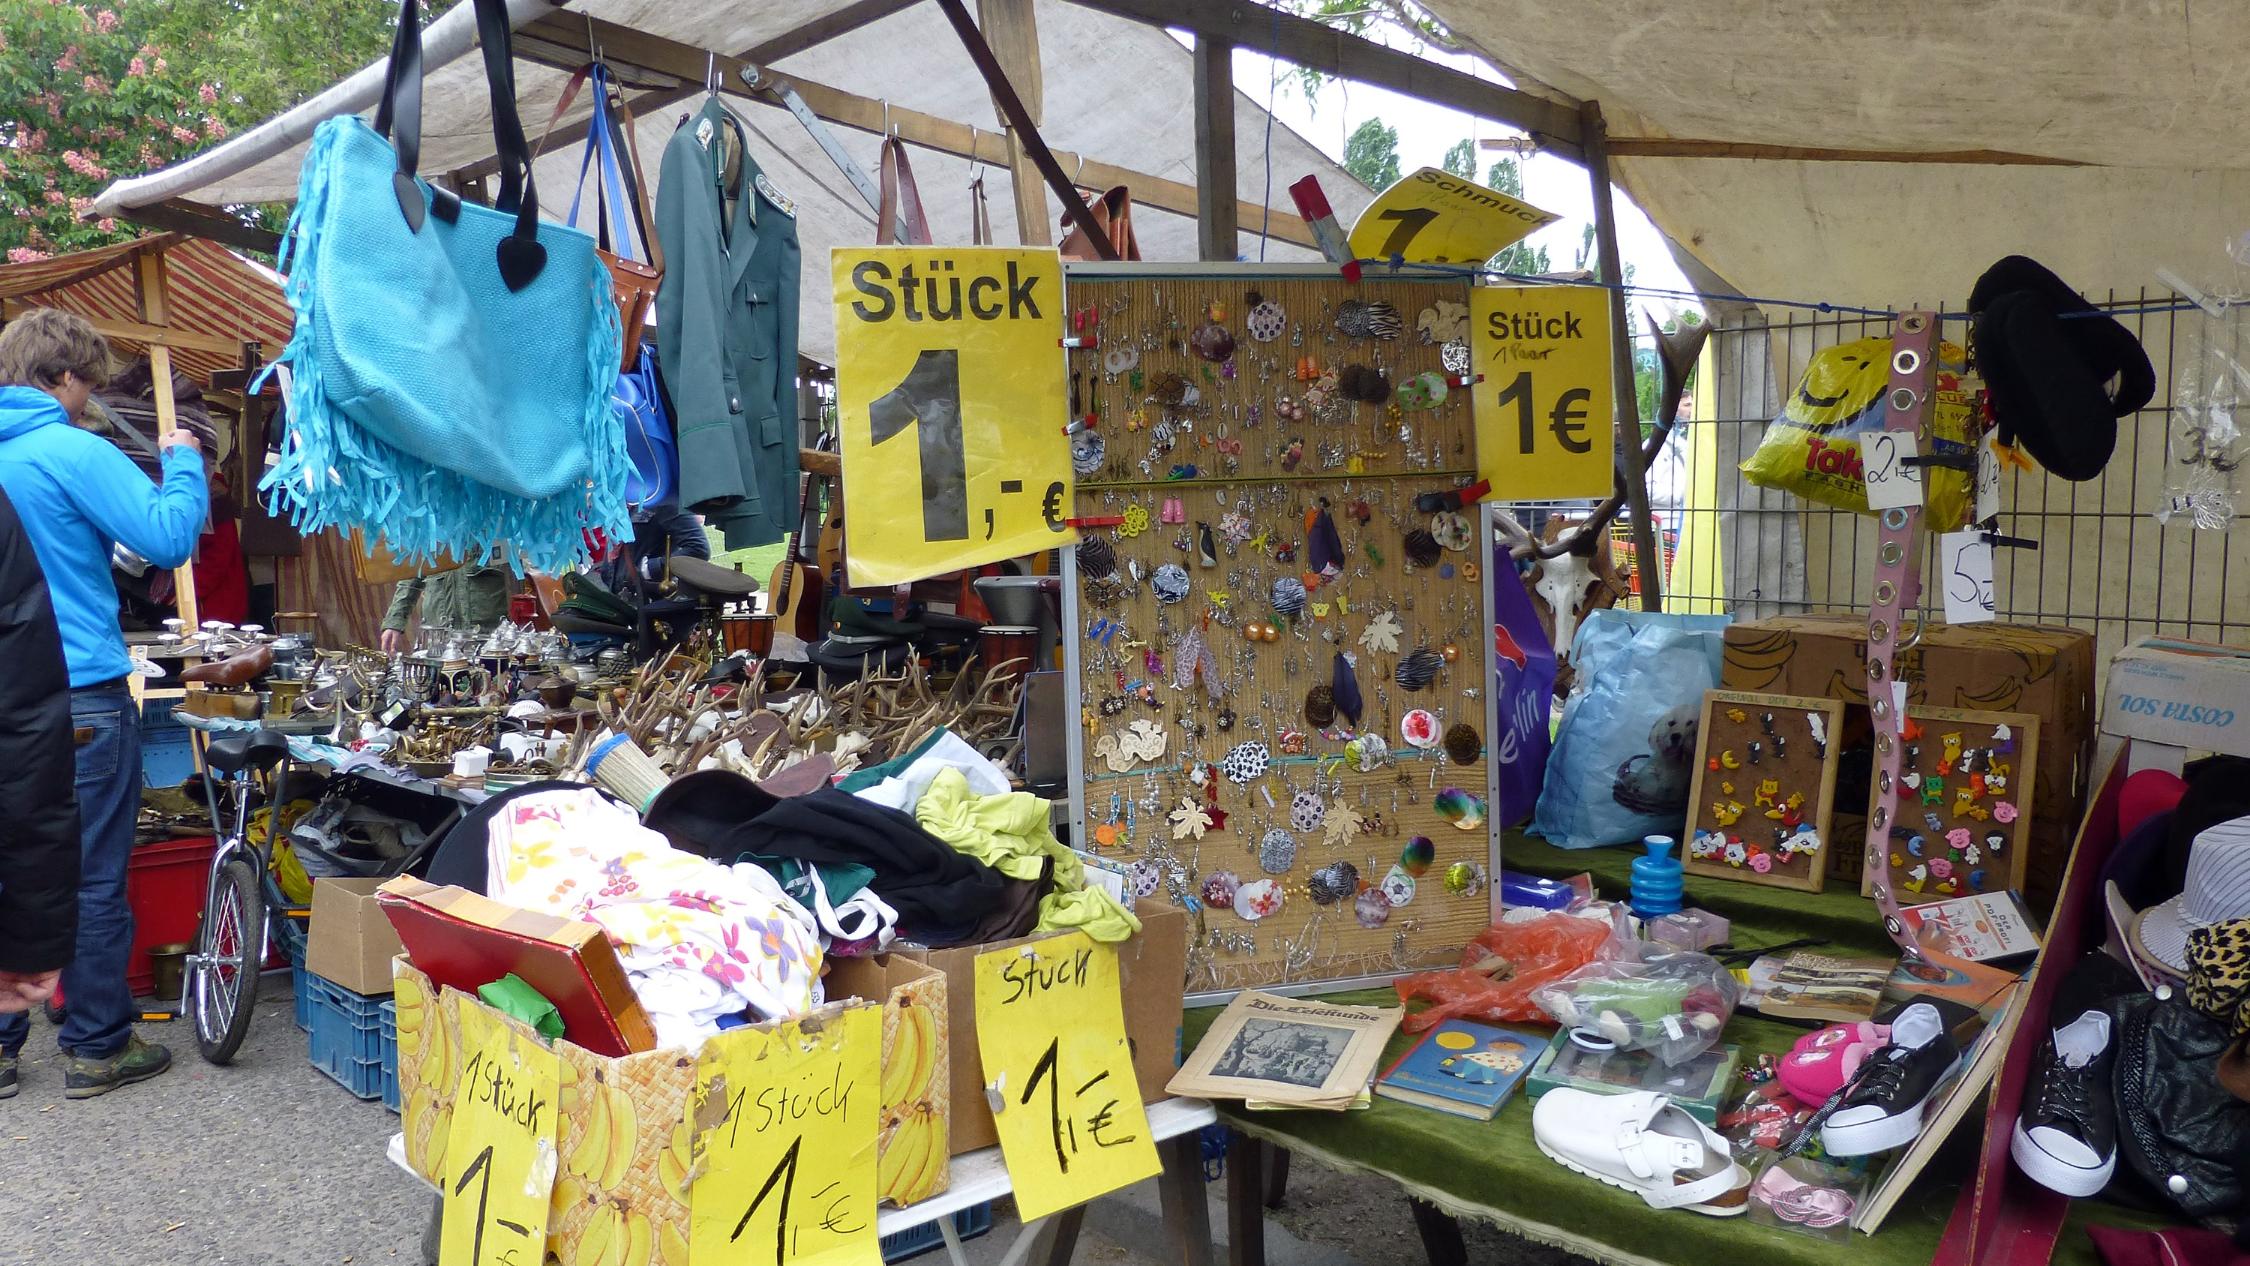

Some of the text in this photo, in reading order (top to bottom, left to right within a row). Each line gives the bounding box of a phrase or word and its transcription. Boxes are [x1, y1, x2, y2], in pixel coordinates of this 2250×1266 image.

[1415, 170, 1551, 227] Schmuck
[851, 260, 1043, 323] Stück
[1488, 311, 1583, 340] Stück
[1806, 436, 1864, 482] Tak
[2119, 693, 2235, 728] COSTA SOL
[479, 1059, 546, 1137] Stück
[755, 1061, 855, 1133] Stück
